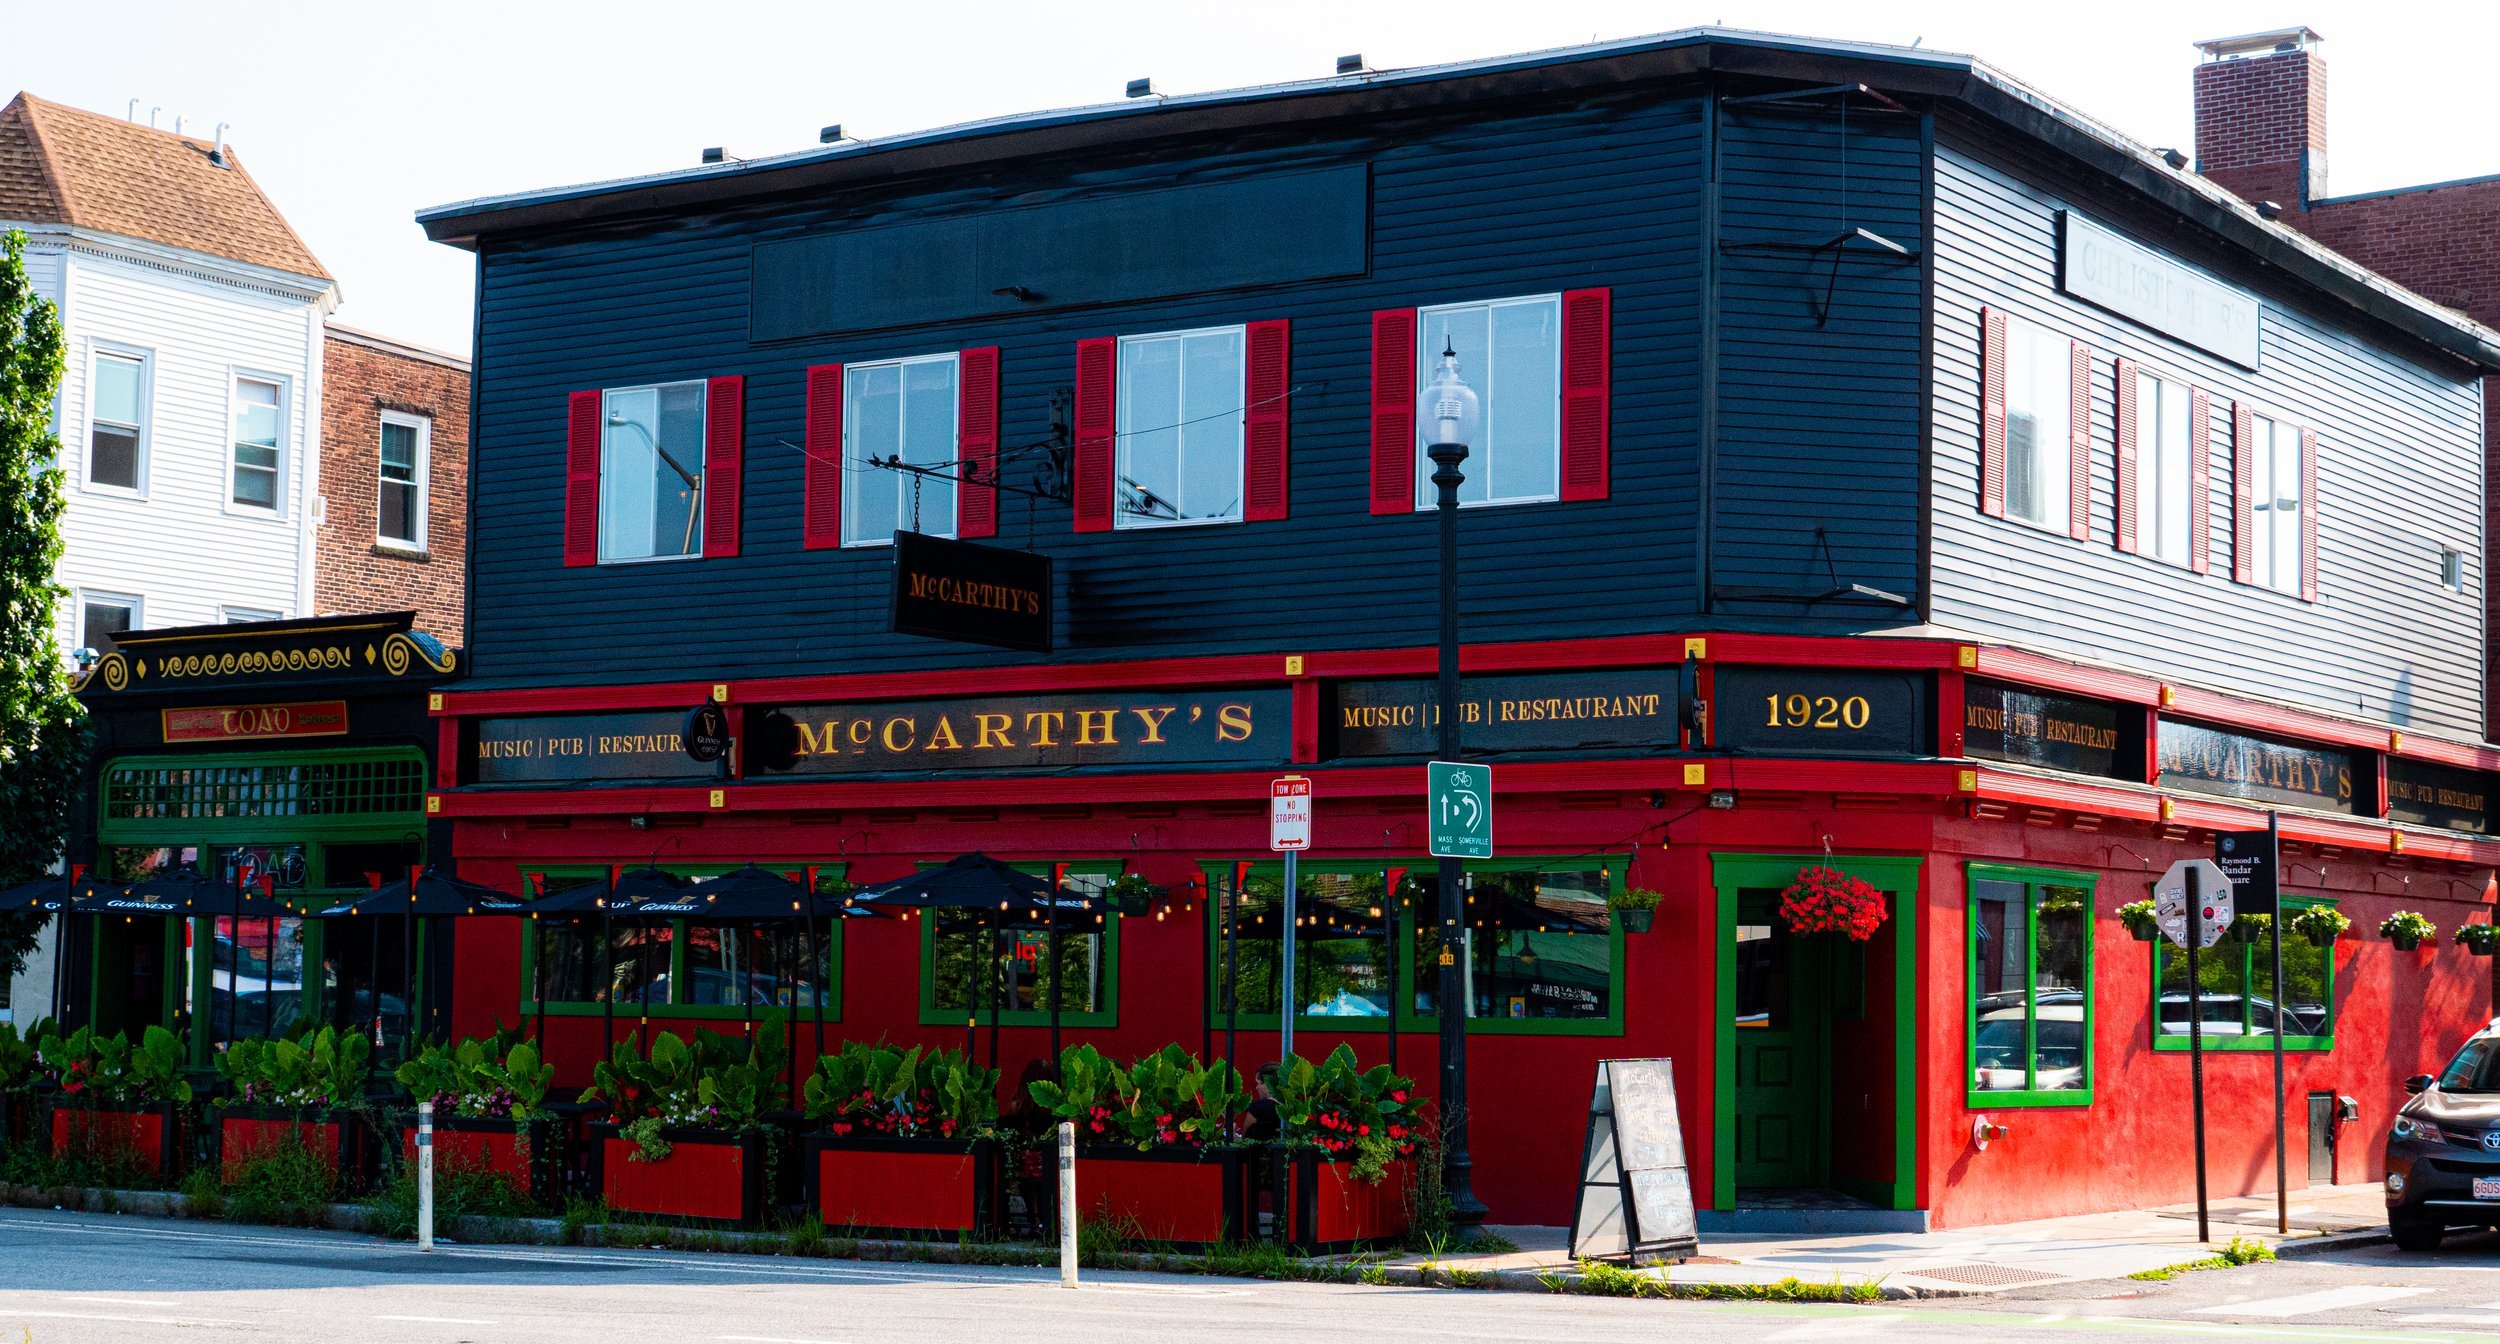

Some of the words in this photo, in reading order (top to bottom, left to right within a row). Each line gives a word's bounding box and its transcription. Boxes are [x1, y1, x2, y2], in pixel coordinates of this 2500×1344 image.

[1344, 706, 1414, 728] MUSIC
[1500, 694, 1659, 721] RESTAURANT
[1766, 693, 1870, 728] 1920
[221, 707, 290, 734] TOAD
[1967, 705, 2006, 732] MUSIC
[2015, 712, 2038, 737] PUB
[2047, 719, 2118, 750] RESTAURANT
[479, 739, 533, 758] MUSIC
[548, 737, 584, 756] PUB
[599, 733, 687, 754] RESTAUR
[1277, 785, 1289, 794] TOW
[1292, 783, 1307, 793] ZONE
[2388, 781, 2413, 799] MUSIC
[2417, 785, 2433, 803] PUB
[2438, 788, 2484, 811] RESTAURANT
[1287, 800, 1296, 810] NO
[1275, 813, 1307, 824] STOPPING
[1438, 836, 1453, 844] MASS
[1459, 836, 1489, 846] SOMERVILLE
[1441, 845, 1451, 853] AVE
[1469, 847, 1479, 855] AVE
[2221, 856, 2252, 866] Raymond
[2253, 856, 2261, 864] B.
[2221, 865, 2252, 875] Bandar
[107, 899, 177, 910] GUINNESS
[2475, 1182, 2500, 1194] 6GDS
